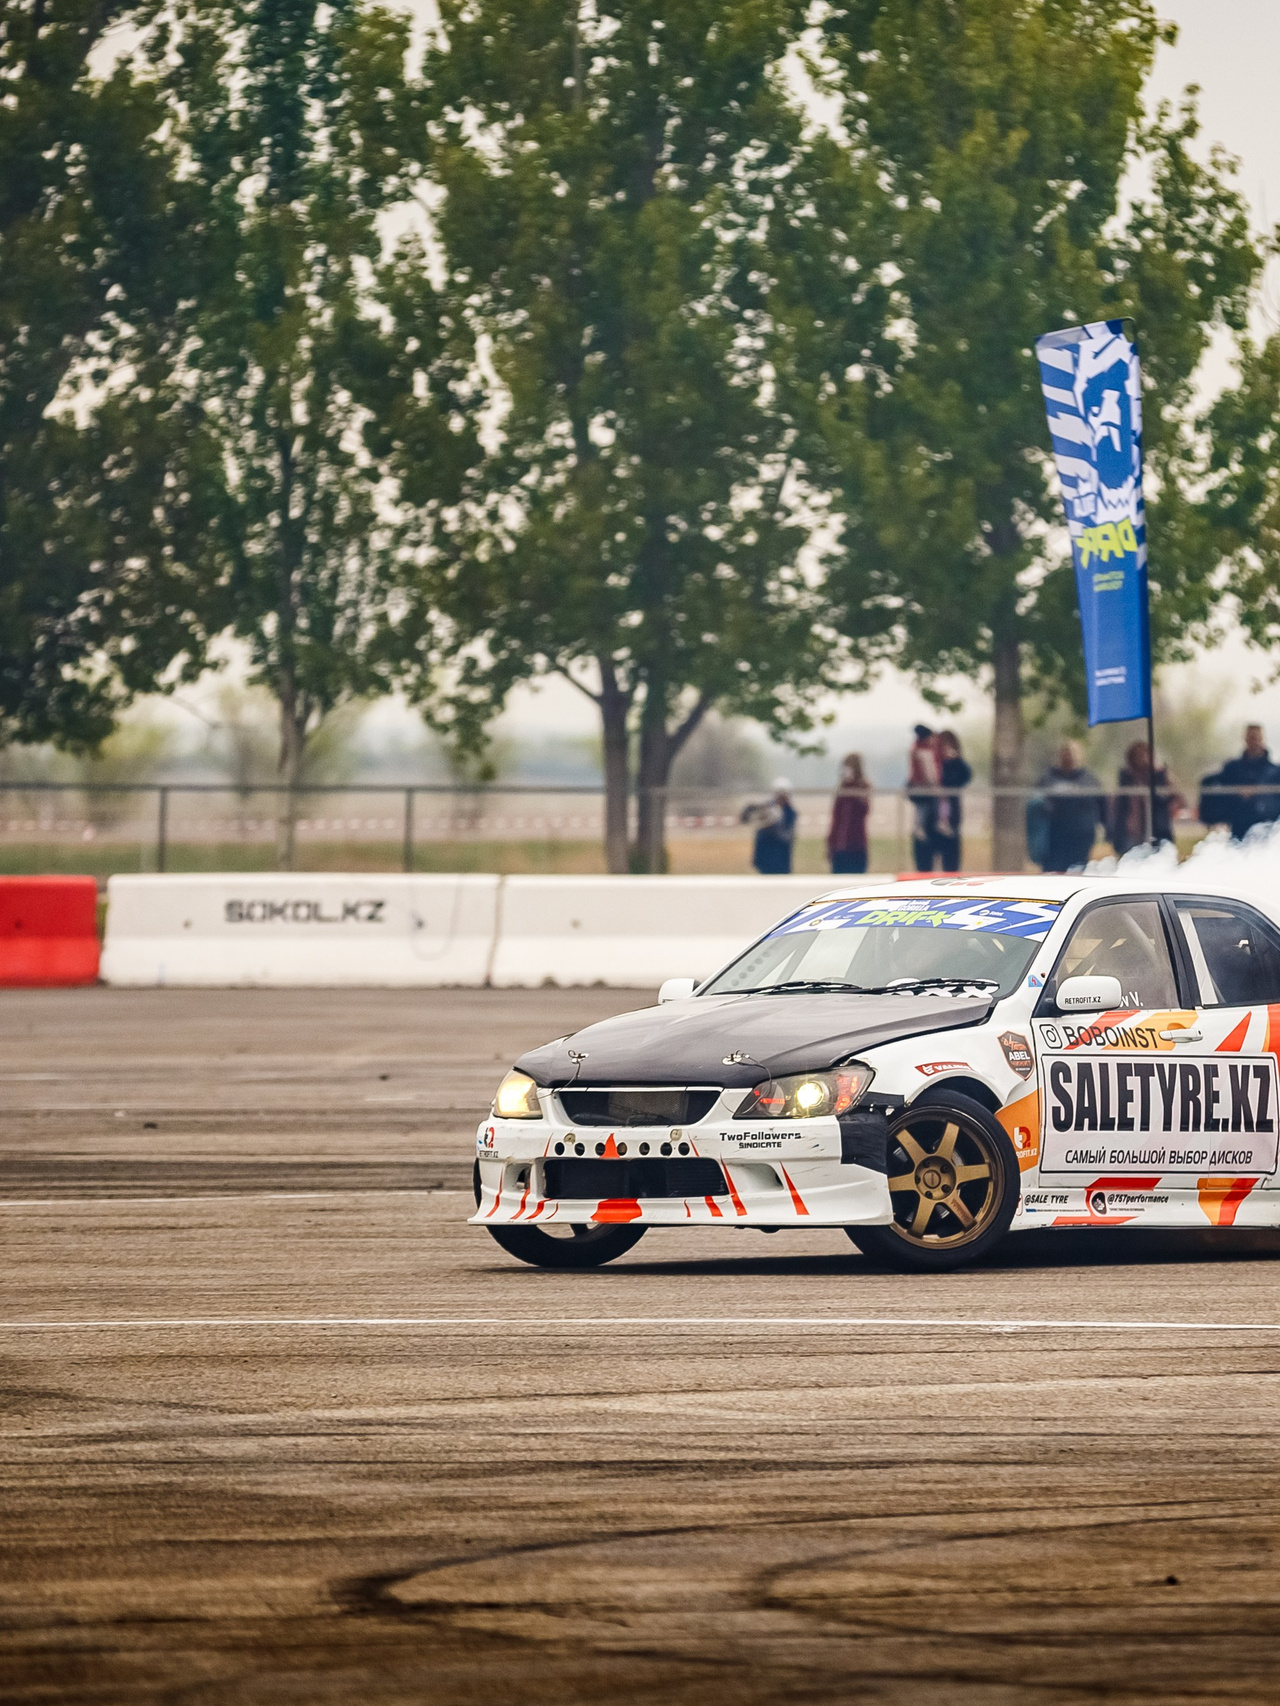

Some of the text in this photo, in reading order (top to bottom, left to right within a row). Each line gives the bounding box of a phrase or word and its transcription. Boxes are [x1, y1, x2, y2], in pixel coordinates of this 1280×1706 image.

[855, 911, 951, 927] DRIFT
[1065, 996, 1101, 1005] RETROFIT.KZ
[1062, 1026, 1158, 1048] BOBOINST
[1009, 1051, 1030, 1061] ABEL
[1050, 1061, 1274, 1132] SALETYRE.KZ
[720, 1132, 802, 1141] TwoFollowers
[1065, 1146, 1253, 1166] САМЫЙ БОЛЬШОЙ ВЫБОР ДИСКОВ
[1107, 1193, 1169, 1205] @757performance
